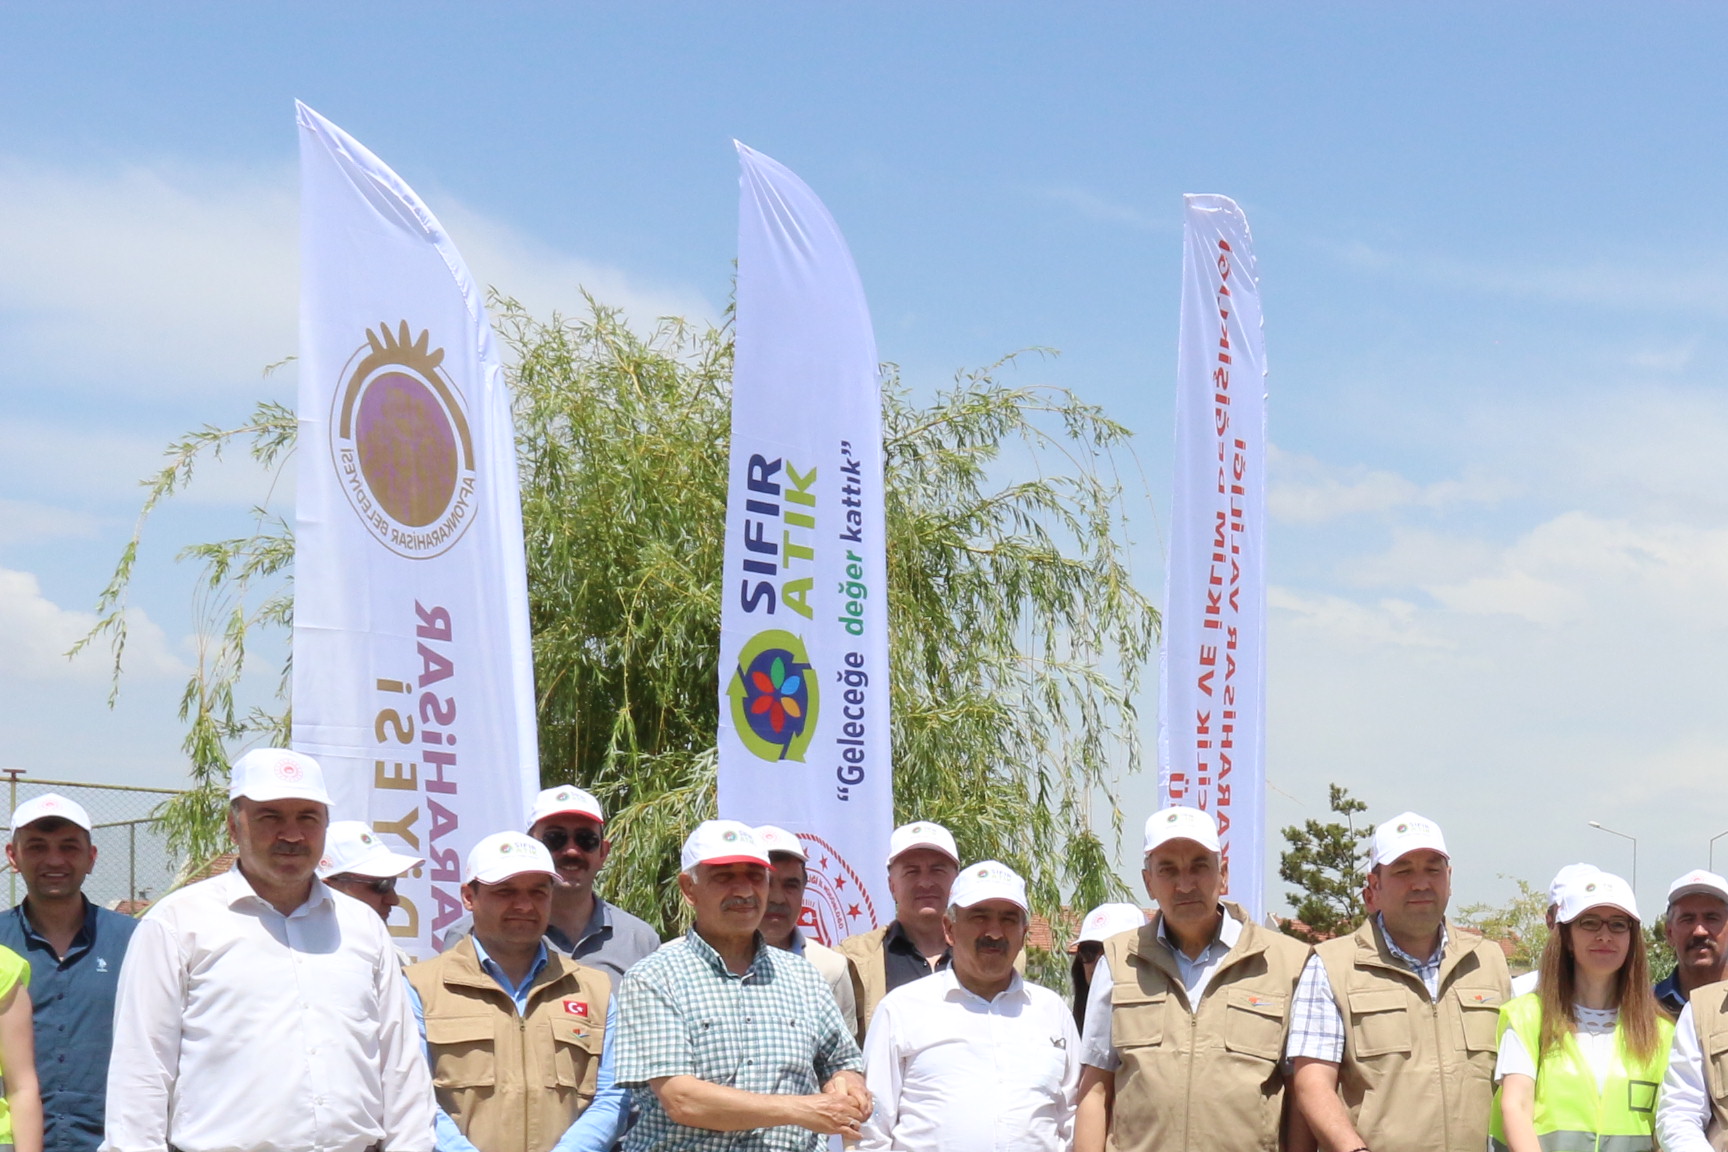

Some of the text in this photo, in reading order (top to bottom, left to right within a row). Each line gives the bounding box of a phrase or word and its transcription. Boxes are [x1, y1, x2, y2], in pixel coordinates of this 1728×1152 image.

[741, 453, 782, 615] SIFIR
[782, 459, 818, 620] ATIK
[838, 549, 869, 636] değer
